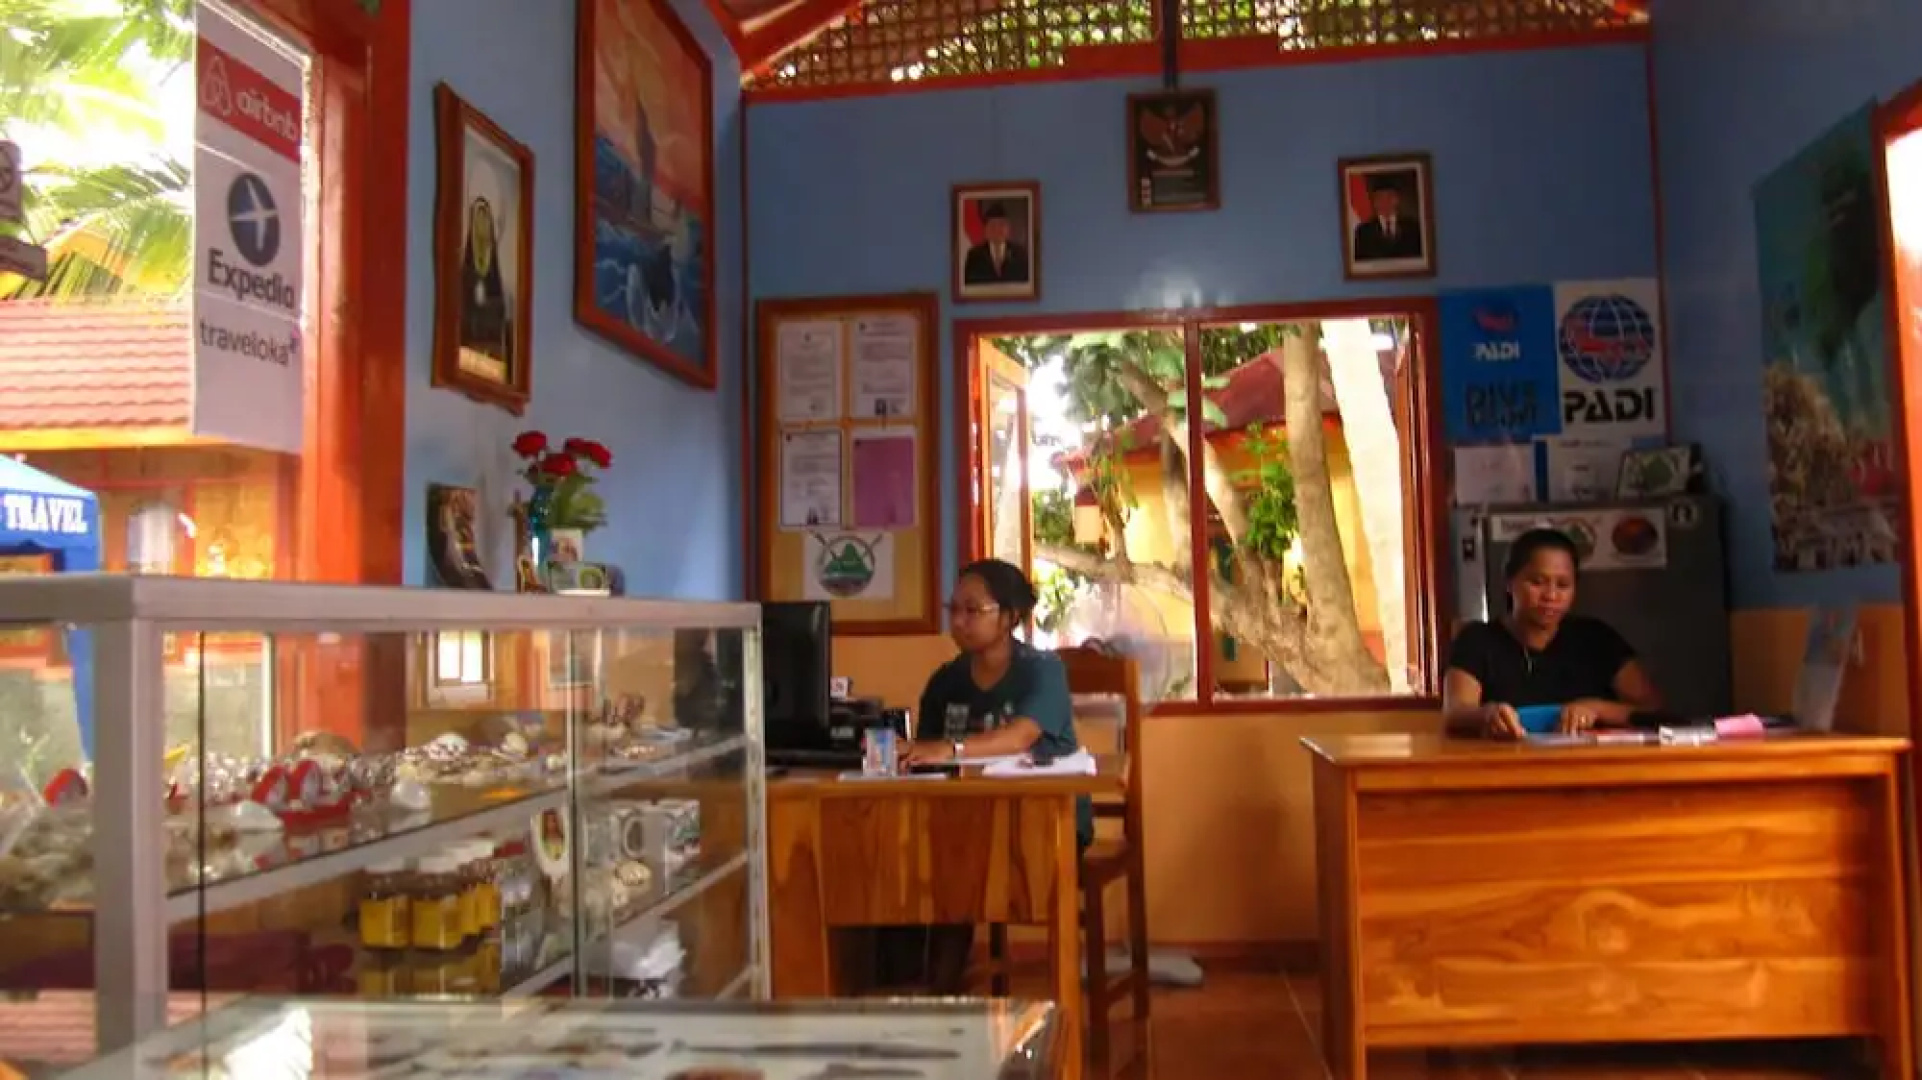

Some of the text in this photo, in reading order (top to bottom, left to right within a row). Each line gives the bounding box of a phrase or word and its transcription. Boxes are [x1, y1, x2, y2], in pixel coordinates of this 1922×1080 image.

[236, 87, 299, 142] airbnb
[207, 247, 295, 310] Expedia
[200, 319, 291, 368] traveloka
[1471, 340, 1521, 361] PADI
[1564, 387, 1656, 424] PADI
[4, 494, 88, 533] TRAVEL
